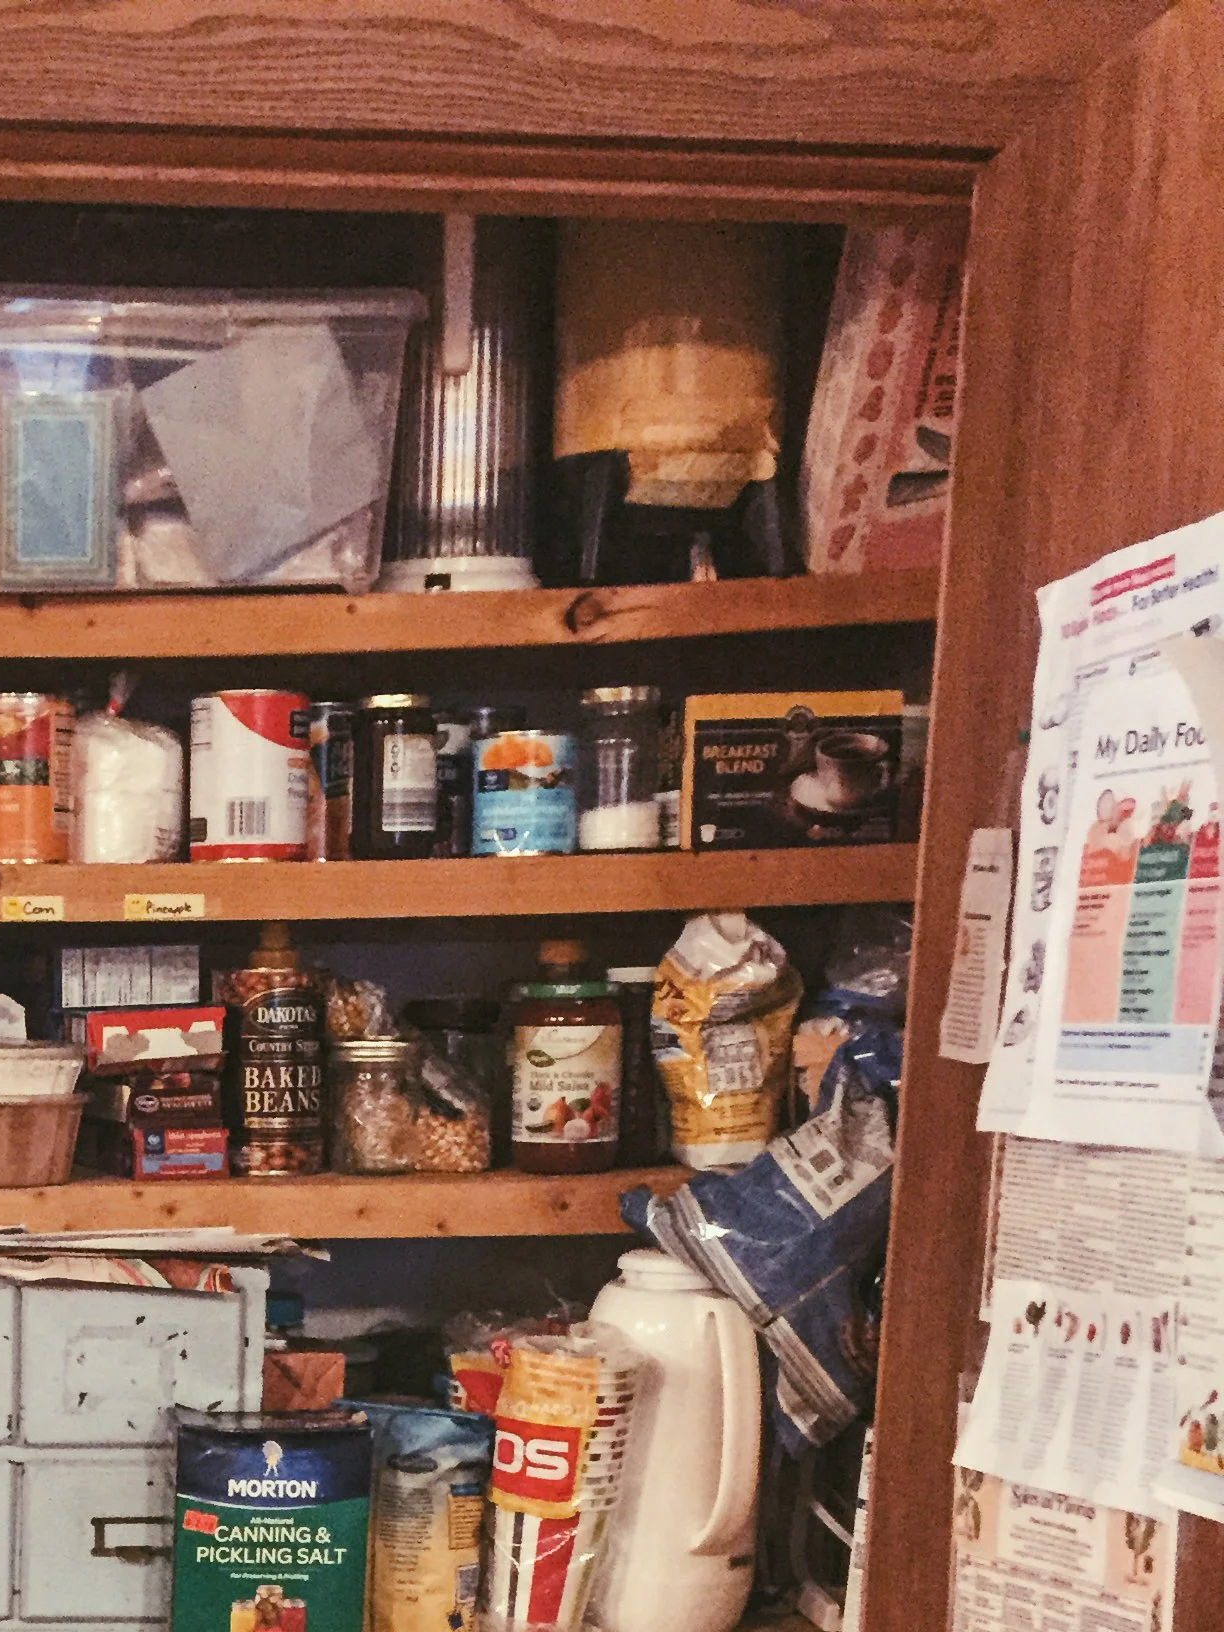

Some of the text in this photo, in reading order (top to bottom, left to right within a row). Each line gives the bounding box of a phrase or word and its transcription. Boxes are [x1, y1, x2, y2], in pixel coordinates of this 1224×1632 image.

[702, 743, 778, 760] BREAKFAST
[1095, 736, 1121, 764] My
[1125, 726, 1169, 757] Daily
[716, 759, 765, 774] BLEND
[23, 901, 55, 915] Corn
[244, 1065, 322, 1088] BAKED
[244, 1089, 321, 1113] BEANS
[227, 1479, 317, 1498] MORTON
[214, 1525, 332, 1544] CANNING &
[196, 1546, 348, 1565] PICKLING SALT
